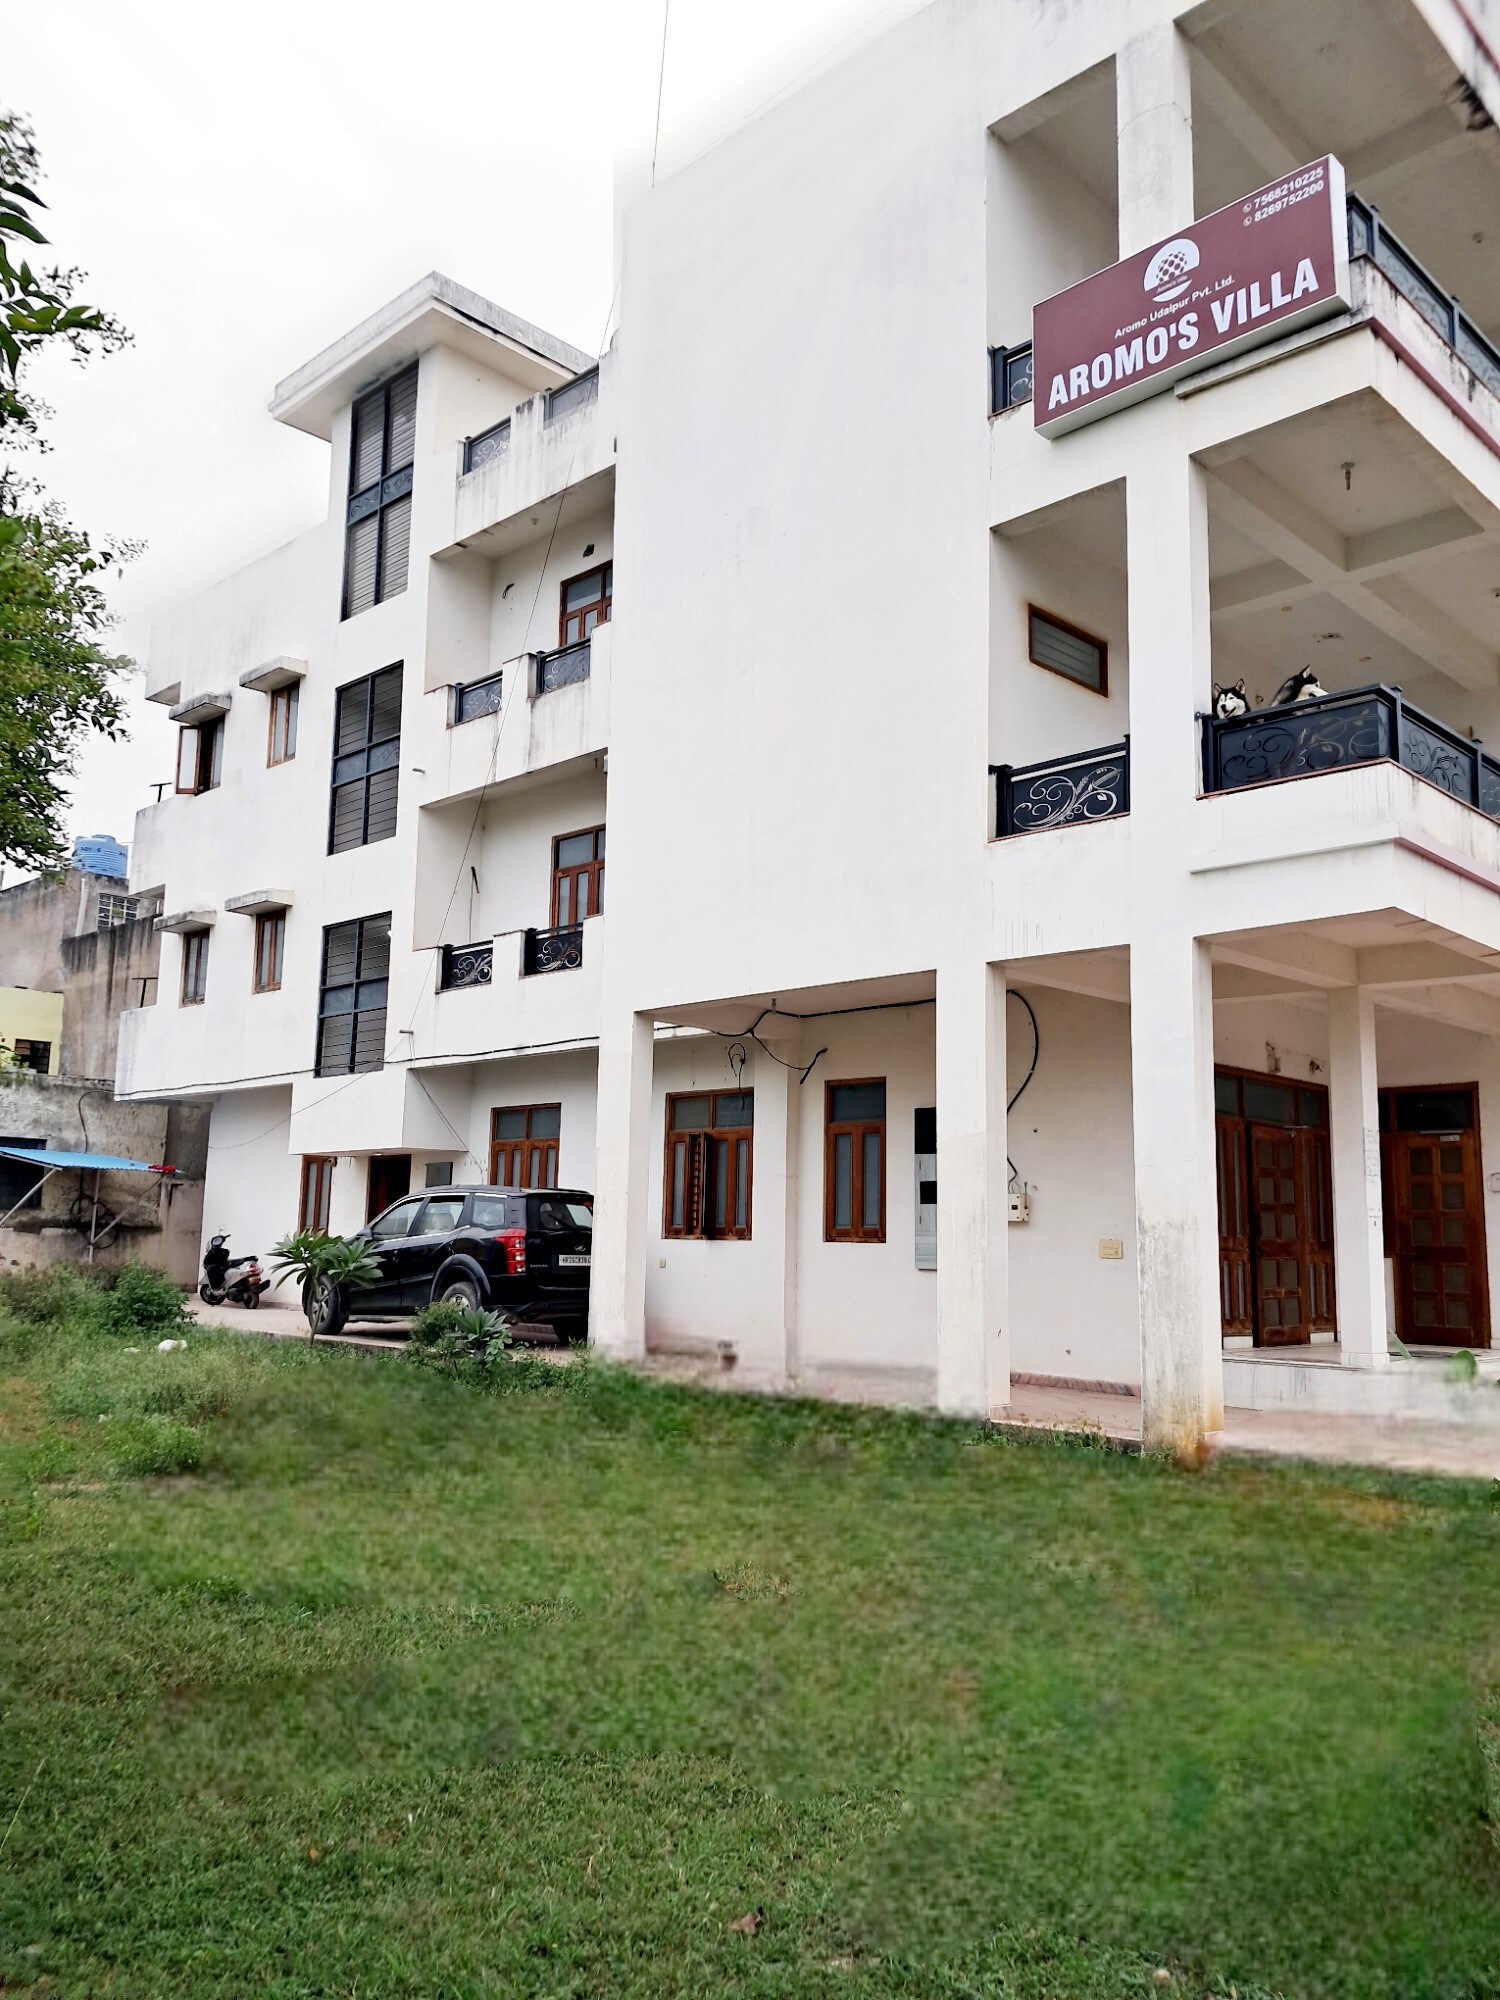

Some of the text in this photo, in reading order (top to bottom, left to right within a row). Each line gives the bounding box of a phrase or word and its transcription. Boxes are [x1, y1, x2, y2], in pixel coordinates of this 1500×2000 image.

[1254, 165, 1324, 209] 7568210225
[1254, 180, 1325, 222] 8269752200
[1114, 274, 1235, 339] Aromo Udaipur Pvt. Ltd.
[1047, 257, 1320, 411] AROMO'S VILLA
